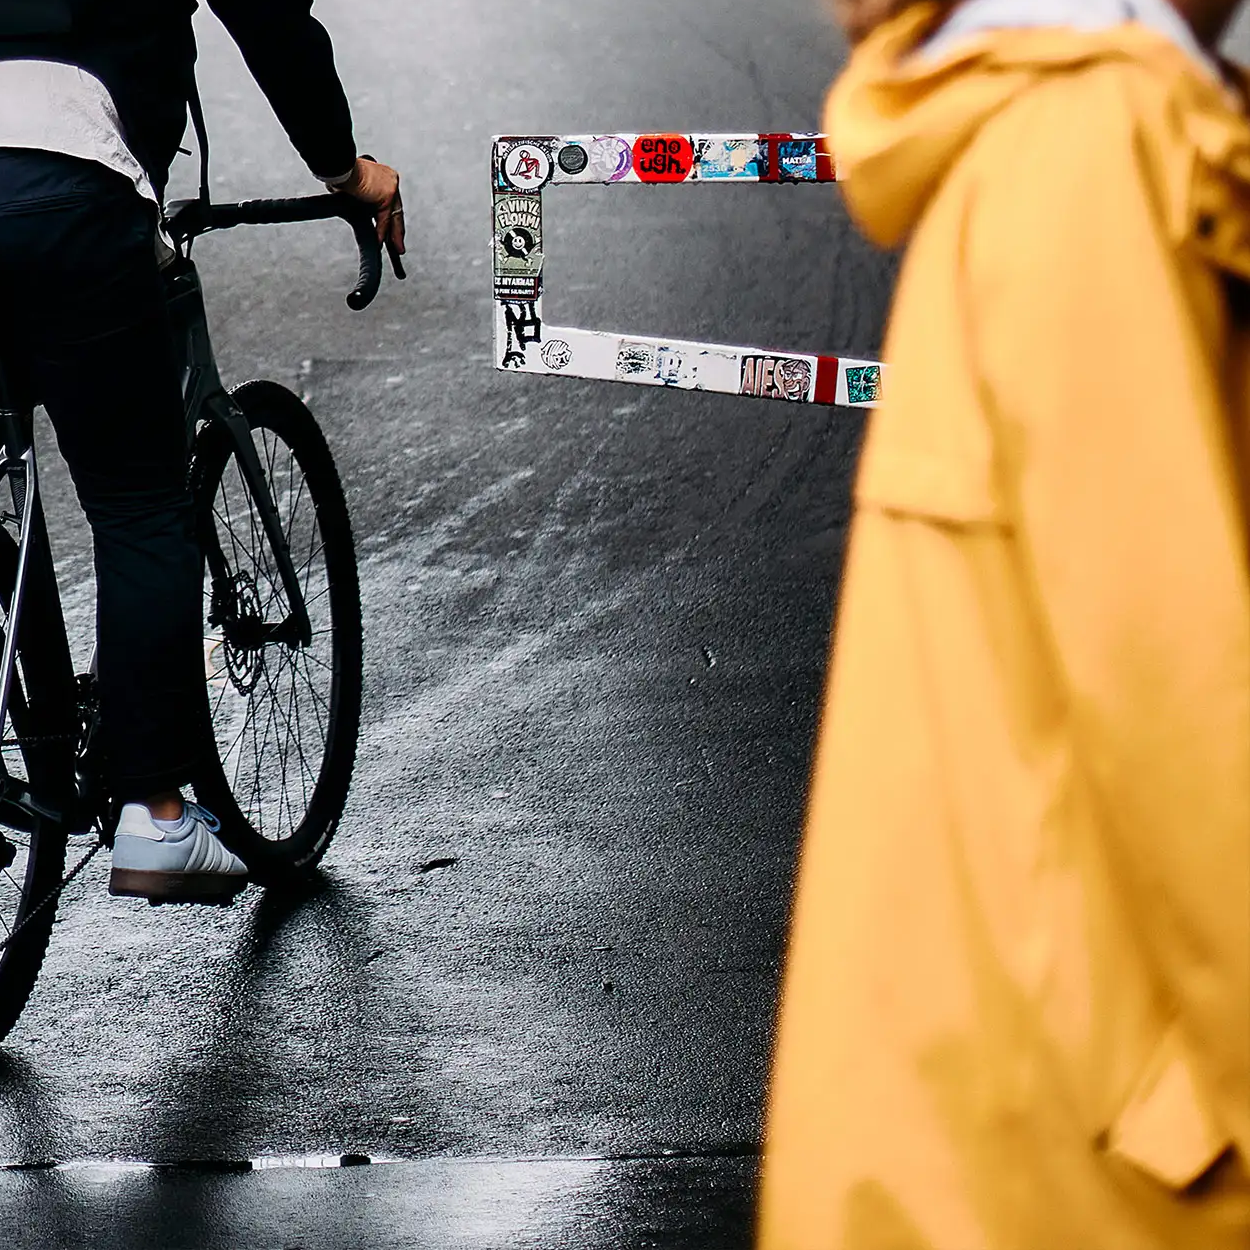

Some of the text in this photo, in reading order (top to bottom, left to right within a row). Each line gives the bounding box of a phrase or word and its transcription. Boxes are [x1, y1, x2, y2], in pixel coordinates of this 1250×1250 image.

[641, 138, 681, 154] eno
[508, 199, 540, 216] VINYL
[498, 213, 541, 229] FLOHMI
